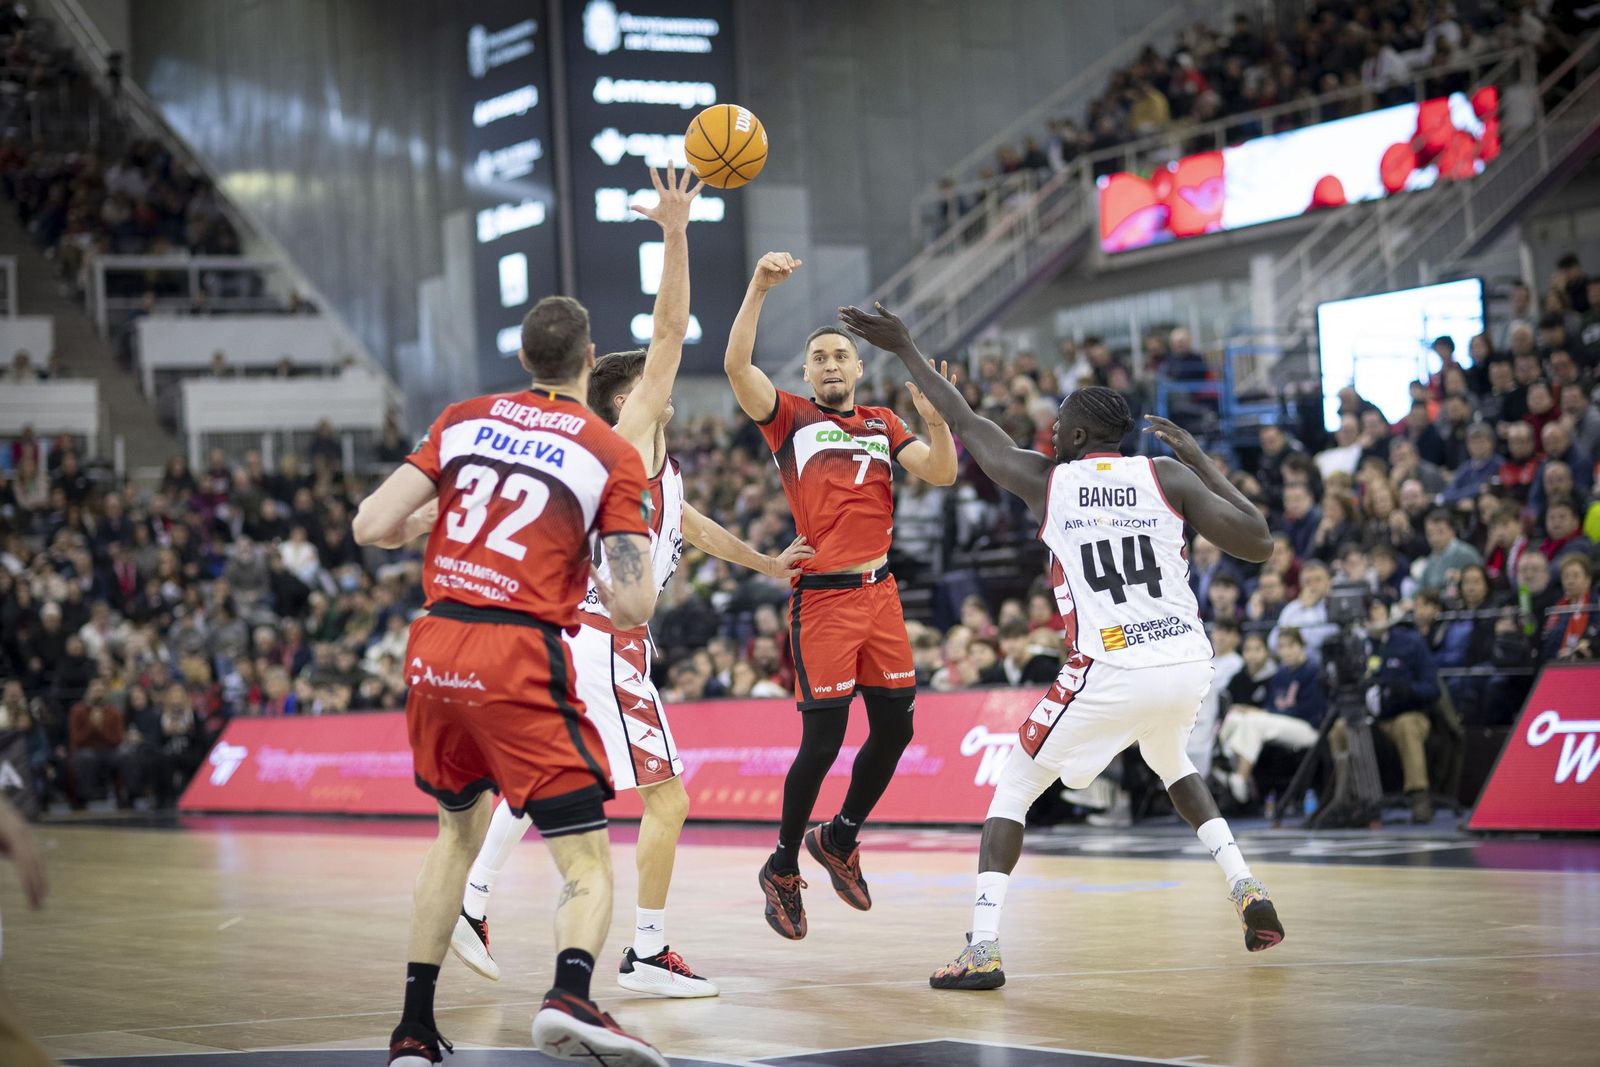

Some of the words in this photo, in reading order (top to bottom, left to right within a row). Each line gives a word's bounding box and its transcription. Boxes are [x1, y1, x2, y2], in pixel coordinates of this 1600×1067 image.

[490, 399, 586, 436] GUERRERO
[474, 426, 566, 469] PULEVA
[852, 454, 872, 485] 7
[446, 464, 550, 561] 32
[1079, 487, 1137, 507] BANGO
[1064, 519, 1084, 530] AIR
[1087, 518, 1158, 530] HRIZONT
[1080, 535, 1163, 605] 44
[1123, 616, 1180, 634] GOBIERNO
[1127, 633, 1145, 646] DE
